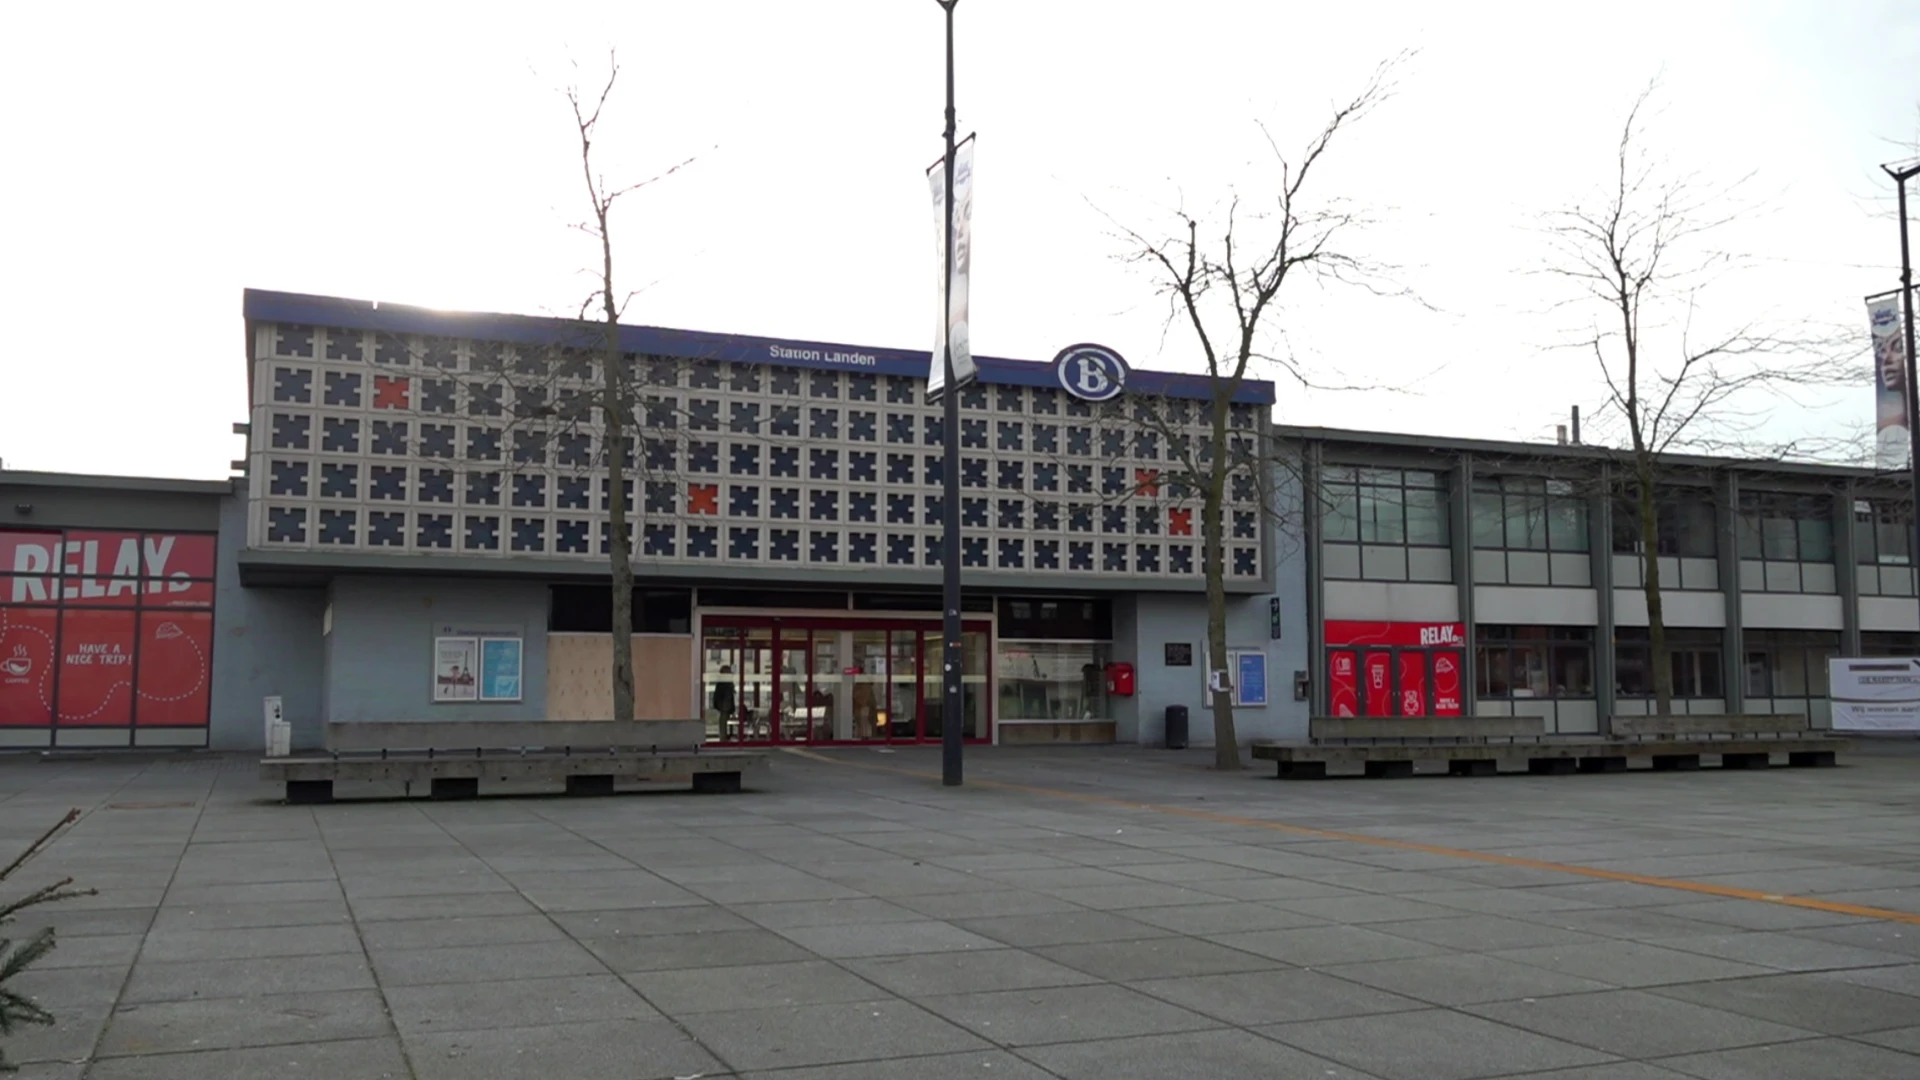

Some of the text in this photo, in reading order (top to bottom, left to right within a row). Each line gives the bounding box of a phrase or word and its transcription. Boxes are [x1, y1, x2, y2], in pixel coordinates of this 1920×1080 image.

[769, 345, 876, 366] Station Landen
[1077, 357, 1108, 392] B
[12, 536, 176, 602] RELAY
[1420, 625, 1454, 645] RELAY
[79, 643, 121, 654] HAVE A
[65, 654, 132, 665] NICE TRIP!
